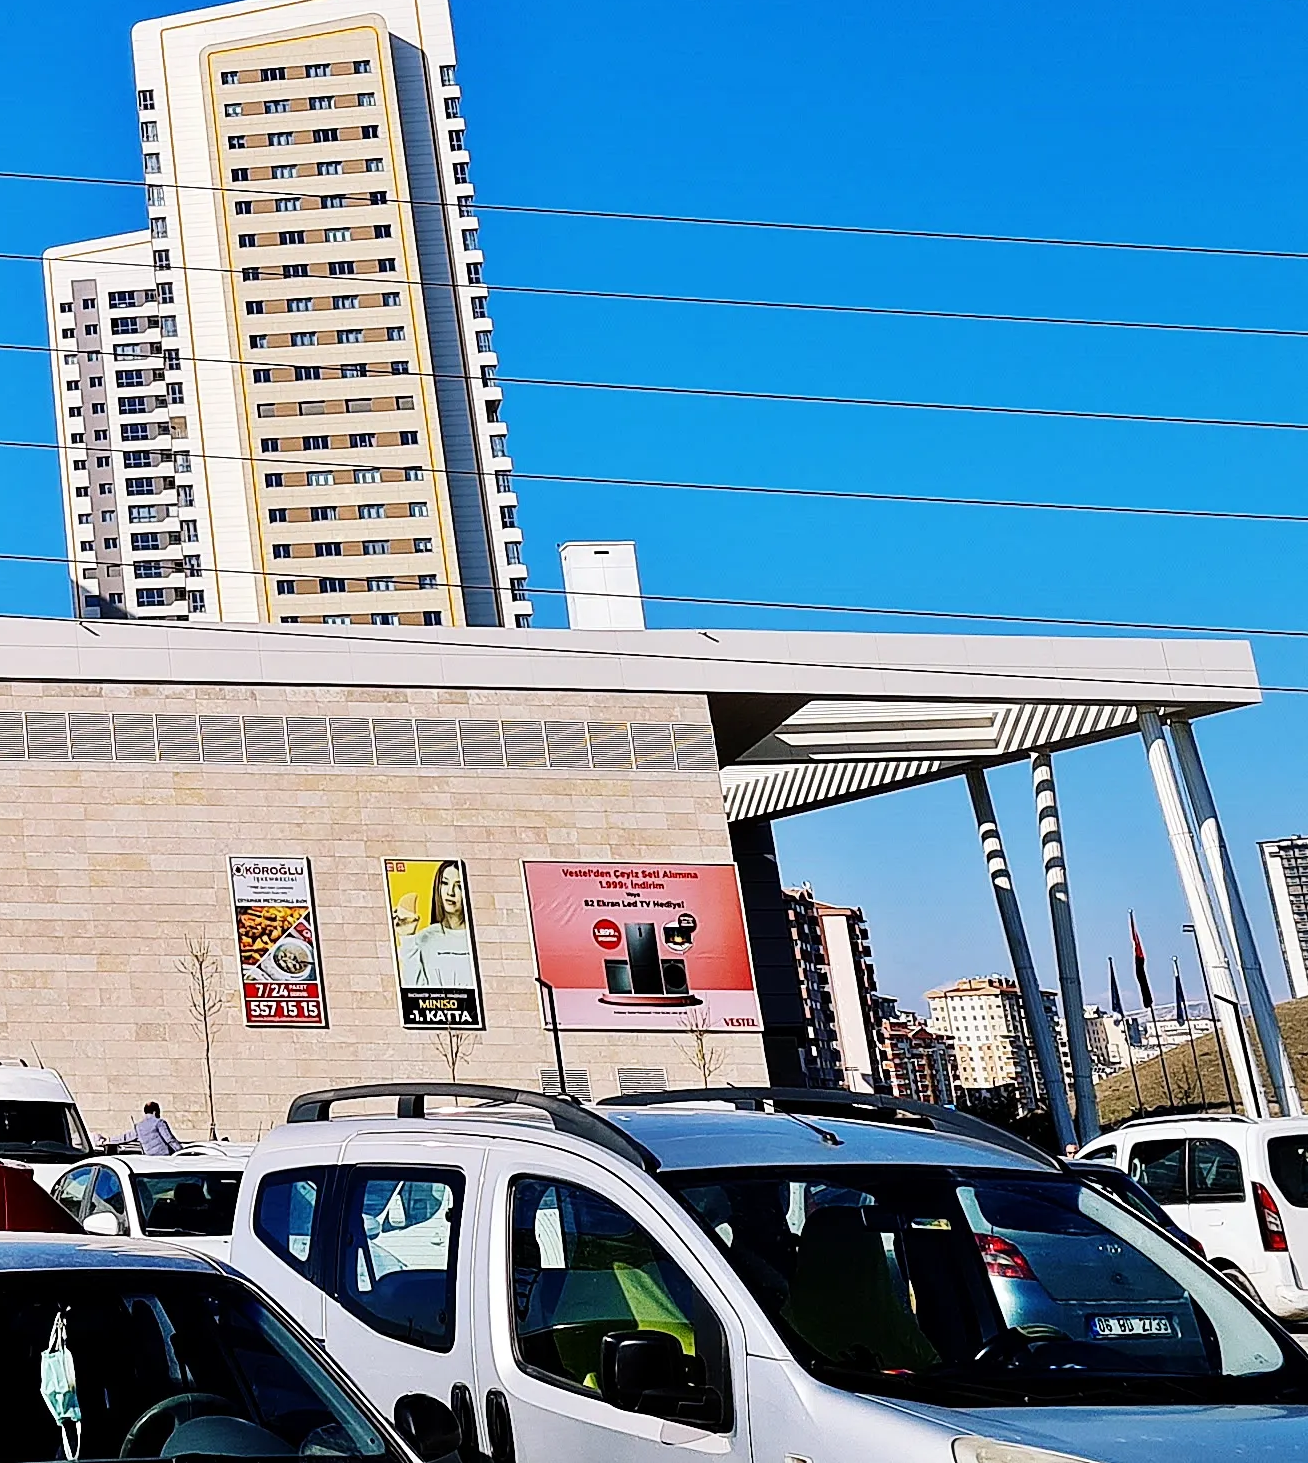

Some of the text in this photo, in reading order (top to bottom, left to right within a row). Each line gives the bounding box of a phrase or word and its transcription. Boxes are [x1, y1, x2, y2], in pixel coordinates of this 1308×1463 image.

[245, 863, 303, 875] KÖROĞLU
[562, 869, 611, 878] Vestel'den
[255, 983, 288, 998] 7/24
[250, 1001, 318, 1016] 557 15 15
[419, 999, 458, 1009] MINISO
[425, 1010, 473, 1023] KATTA
[723, 1017, 758, 1027] VESTEL
[1097, 1317, 1113, 1332] 06
